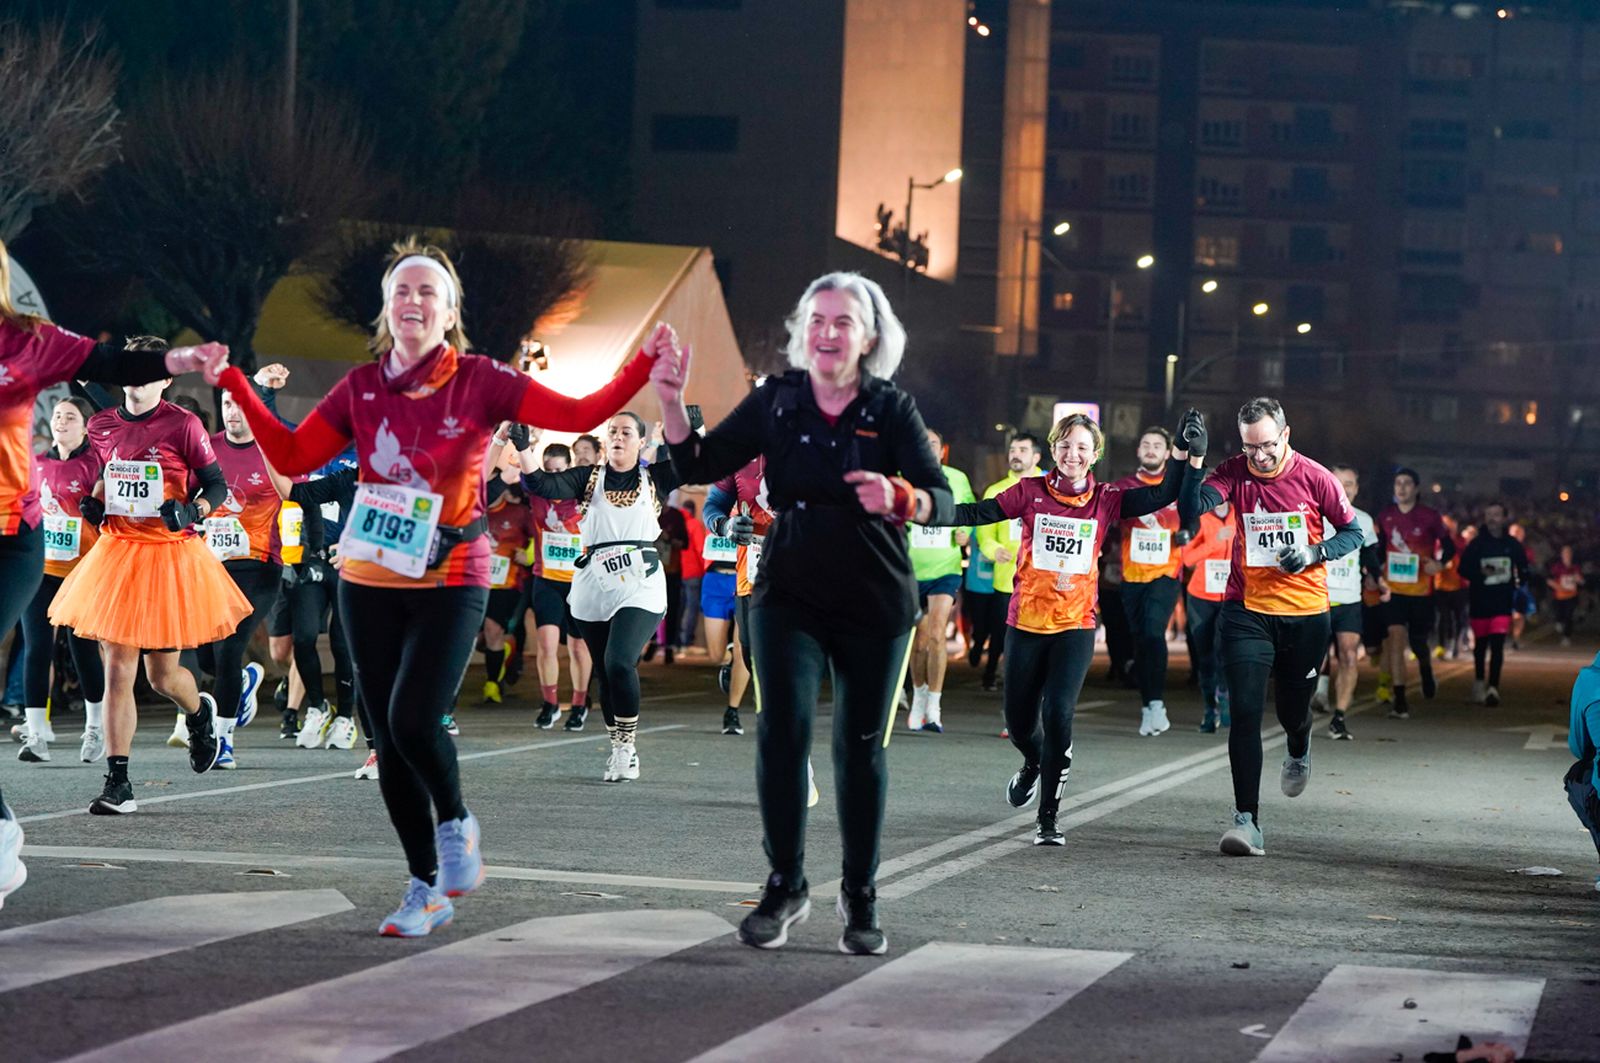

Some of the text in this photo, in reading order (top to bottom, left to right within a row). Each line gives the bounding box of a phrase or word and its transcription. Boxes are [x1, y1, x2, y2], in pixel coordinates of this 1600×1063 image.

[388, 463, 412, 483] 43
[117, 480, 149, 498] 2713
[362, 508, 417, 544] 8193
[548, 545, 576, 558] 9389
[1045, 535, 1083, 555] 5521
[1138, 541, 1163, 552] 6404
[602, 553, 632, 574] 1670
